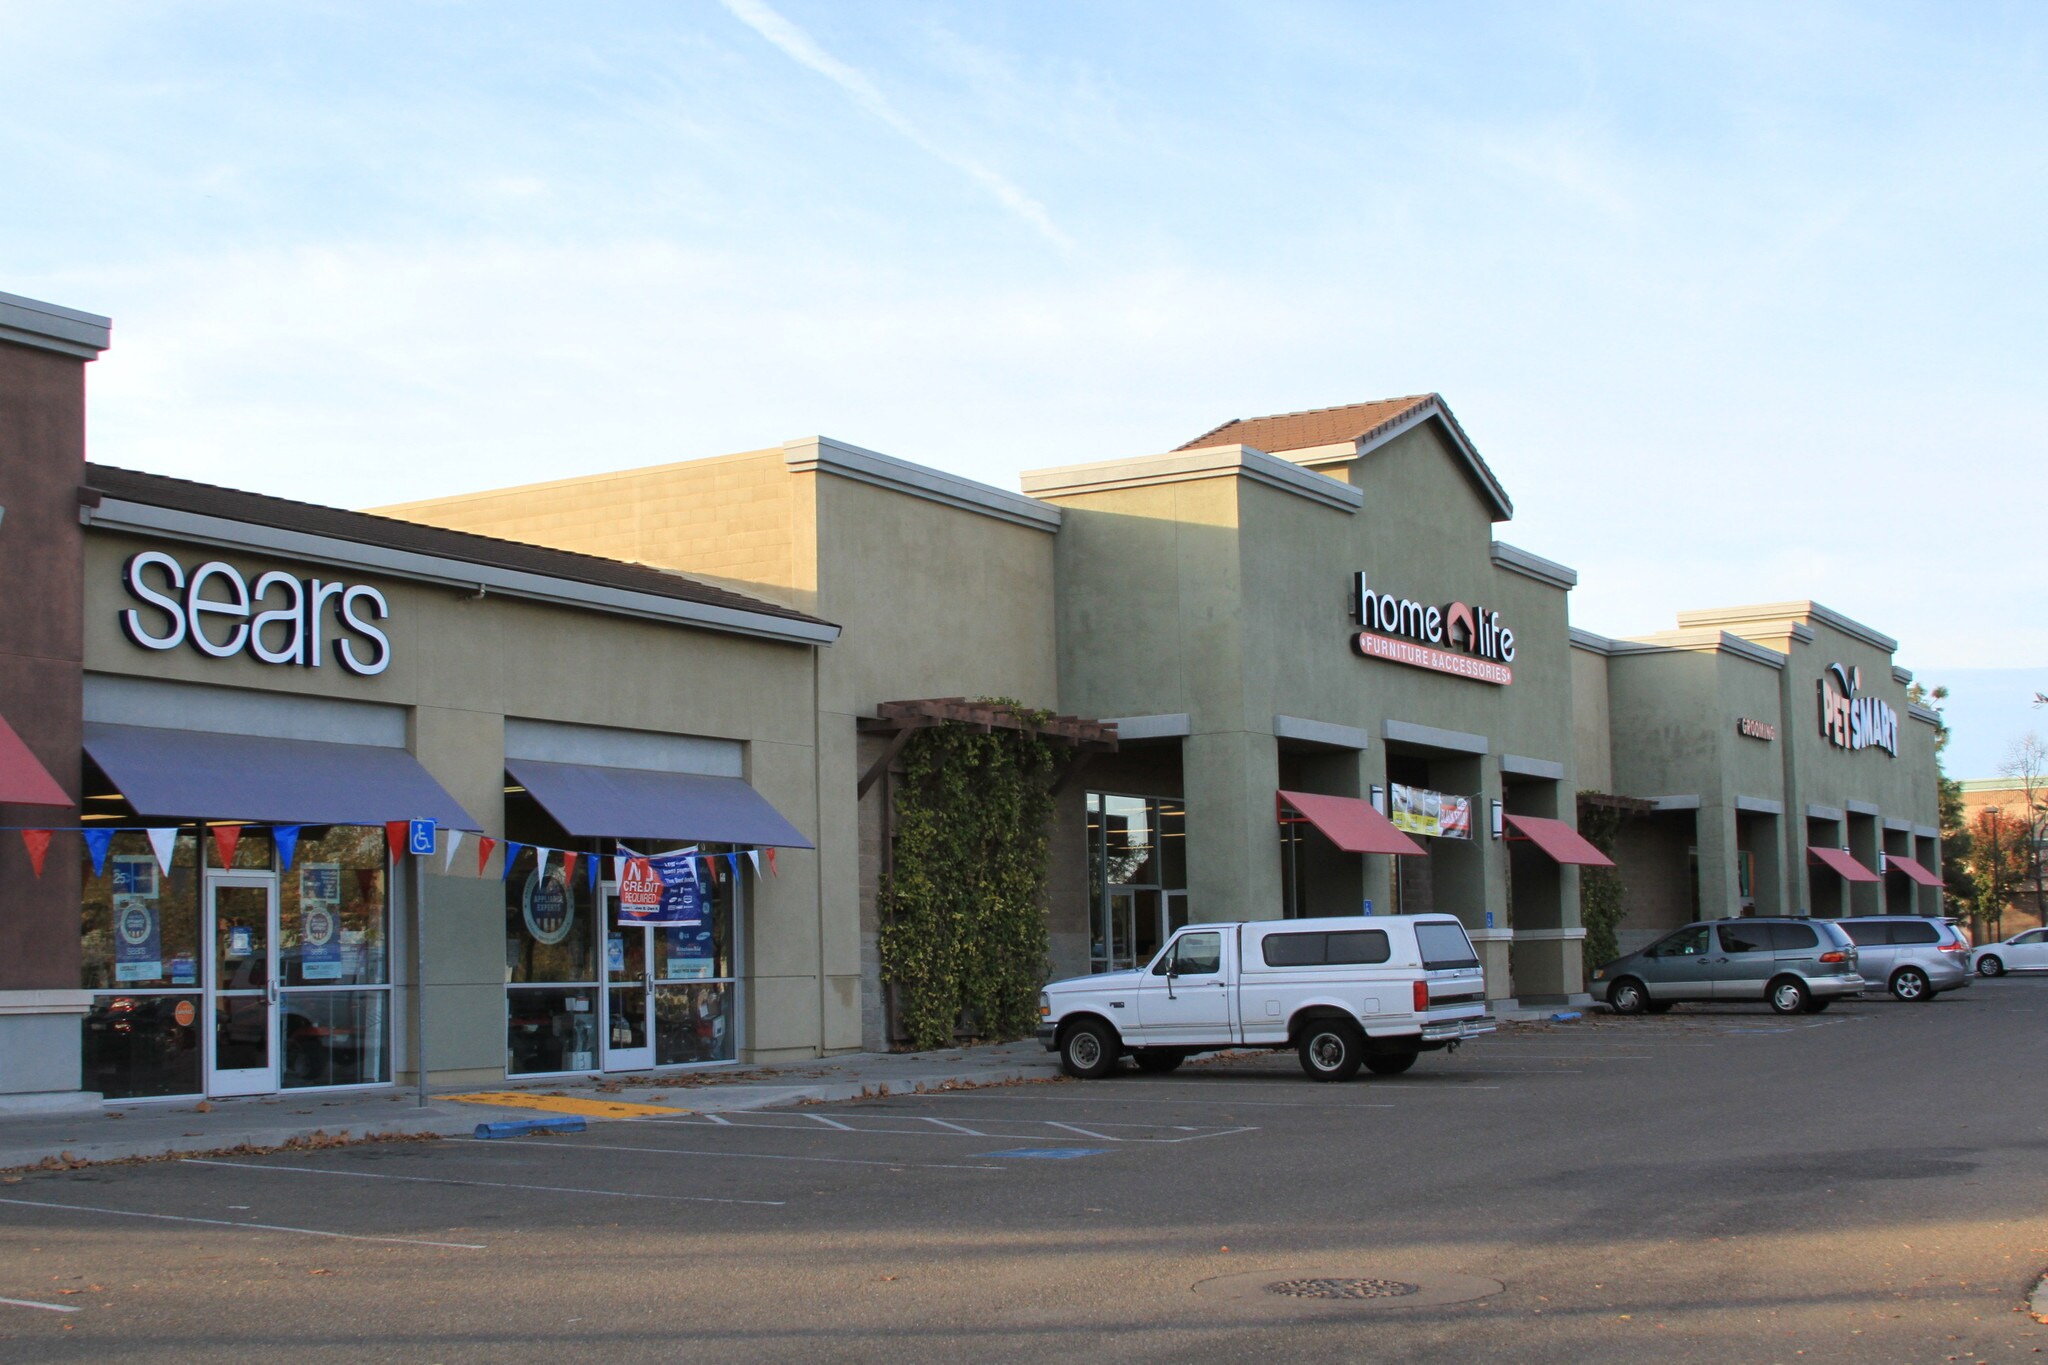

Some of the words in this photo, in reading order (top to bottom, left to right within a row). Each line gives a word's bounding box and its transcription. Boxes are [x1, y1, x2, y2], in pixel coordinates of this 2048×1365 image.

[122, 551, 391, 676] sears
[1356, 571, 1443, 643] home
[1473, 606, 1515, 662] life
[1366, 637, 1429, 665] FURNITURE
[1741, 717, 1775, 741] GROOMING
[623, 880, 660, 893] CREDIT
[624, 892, 656, 903] REQUIRED
